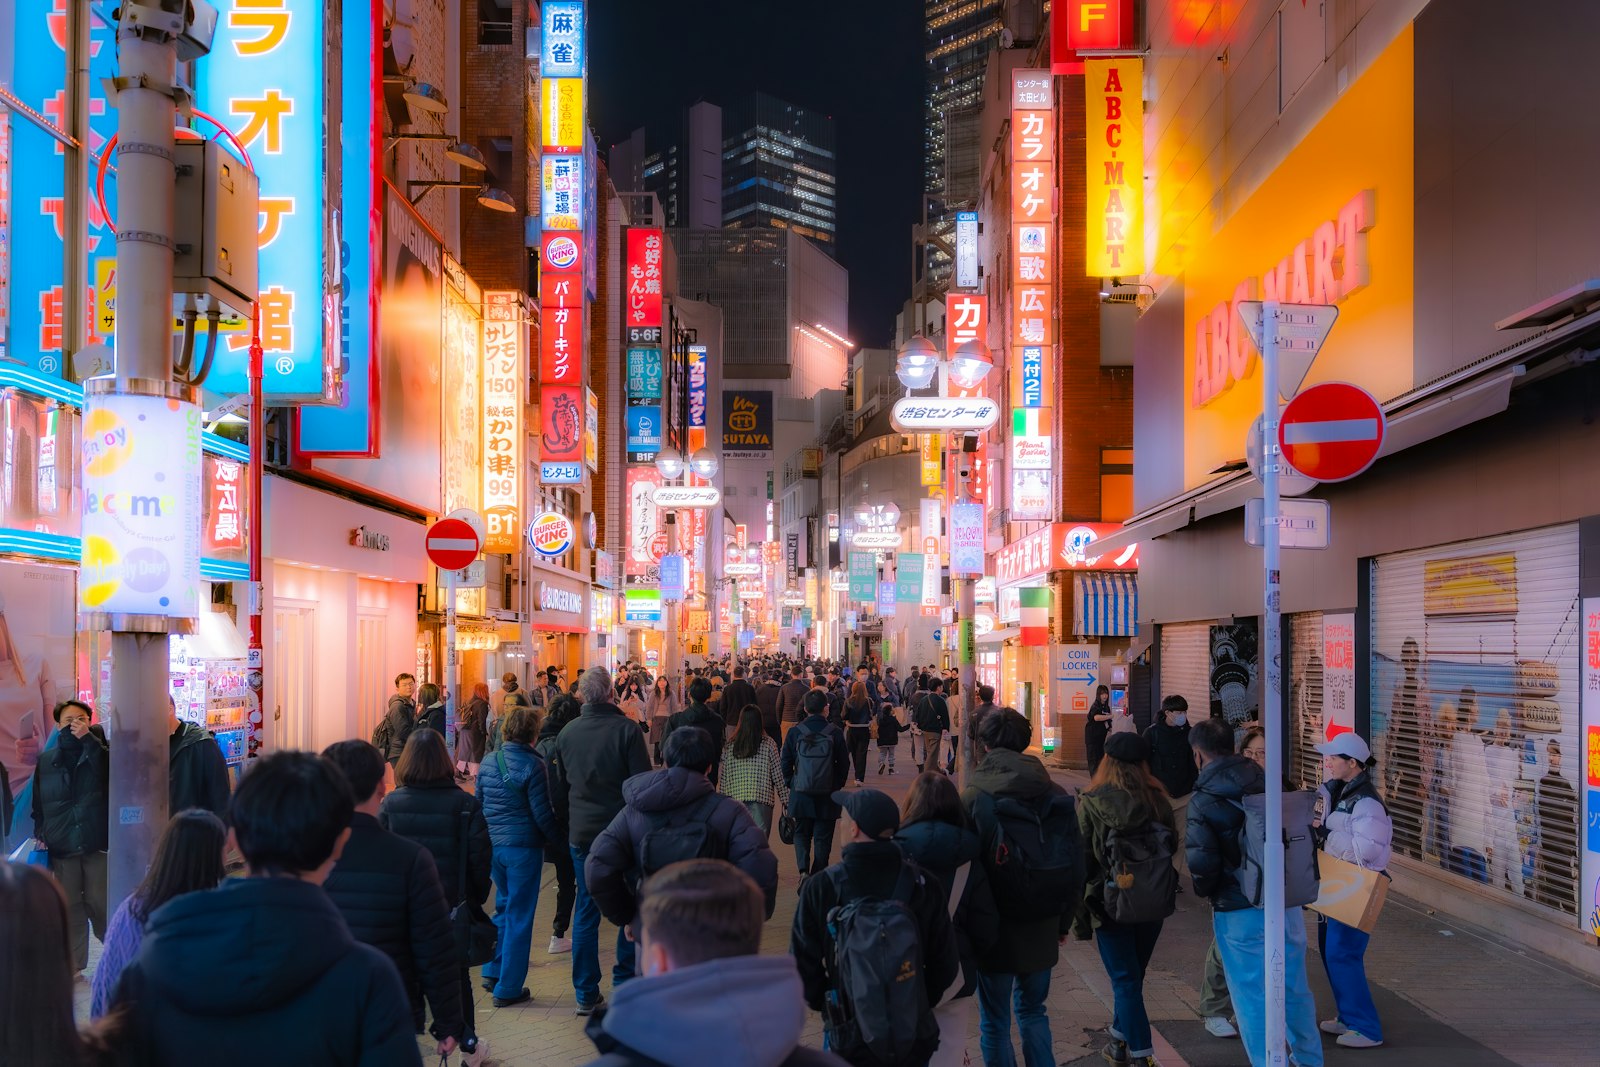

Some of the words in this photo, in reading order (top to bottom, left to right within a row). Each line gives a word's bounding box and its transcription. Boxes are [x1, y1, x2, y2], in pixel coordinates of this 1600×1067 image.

[1080, 4, 1107, 32] F
[552, 13, 573, 63] 麻雀
[1016, 80, 1049, 89] センター街
[1019, 92, 1047, 103] 太田ビル
[1021, 113, 1045, 217] カラオケ
[959, 213, 976, 221] CBR
[391, 201, 440, 278] ORIGINALS
[550, 243, 573, 254] BURGER
[551, 248, 574, 261] KING
[645, 235, 661, 294] お好み焼
[630, 264, 645, 322] もんじゃ
[1019, 256, 1046, 342] 歌広場
[554, 281, 570, 379] バーガーキング
[485, 327, 500, 375] サワー
[501, 323, 516, 374] レモン
[630, 351, 645, 391] 無呼吸
[646, 350, 660, 391] いびき
[1024, 348, 1041, 405] 受付2F
[486, 378, 515, 393] 150
[487, 405, 515, 418] 秘伝
[899, 406, 993, 419] 渋谷センター街
[488, 419, 513, 476] かわ串
[636, 453, 654, 461] B1F
[542, 467, 581, 478] センタービル
[488, 480, 513, 496] 99
[656, 492, 718, 501] 渋谷センター街
[487, 514, 513, 534] B1
[534, 520, 567, 535] BURGER
[535, 528, 568, 547] KING
[997, 528, 1050, 579] カラオケ歌広場
[547, 587, 569, 611] BURGER
[569, 591, 582, 613] KING
[925, 607, 936, 615] B1
[1325, 624, 1353, 638] カラオケルーム
[1068, 651, 1090, 659] COIN
[1325, 640, 1354, 670] 歌広場
[1062, 662, 1098, 670] LOCKER
[1325, 673, 1354, 688] 渋谷センター街
[1332, 689, 1346, 710] 別館
